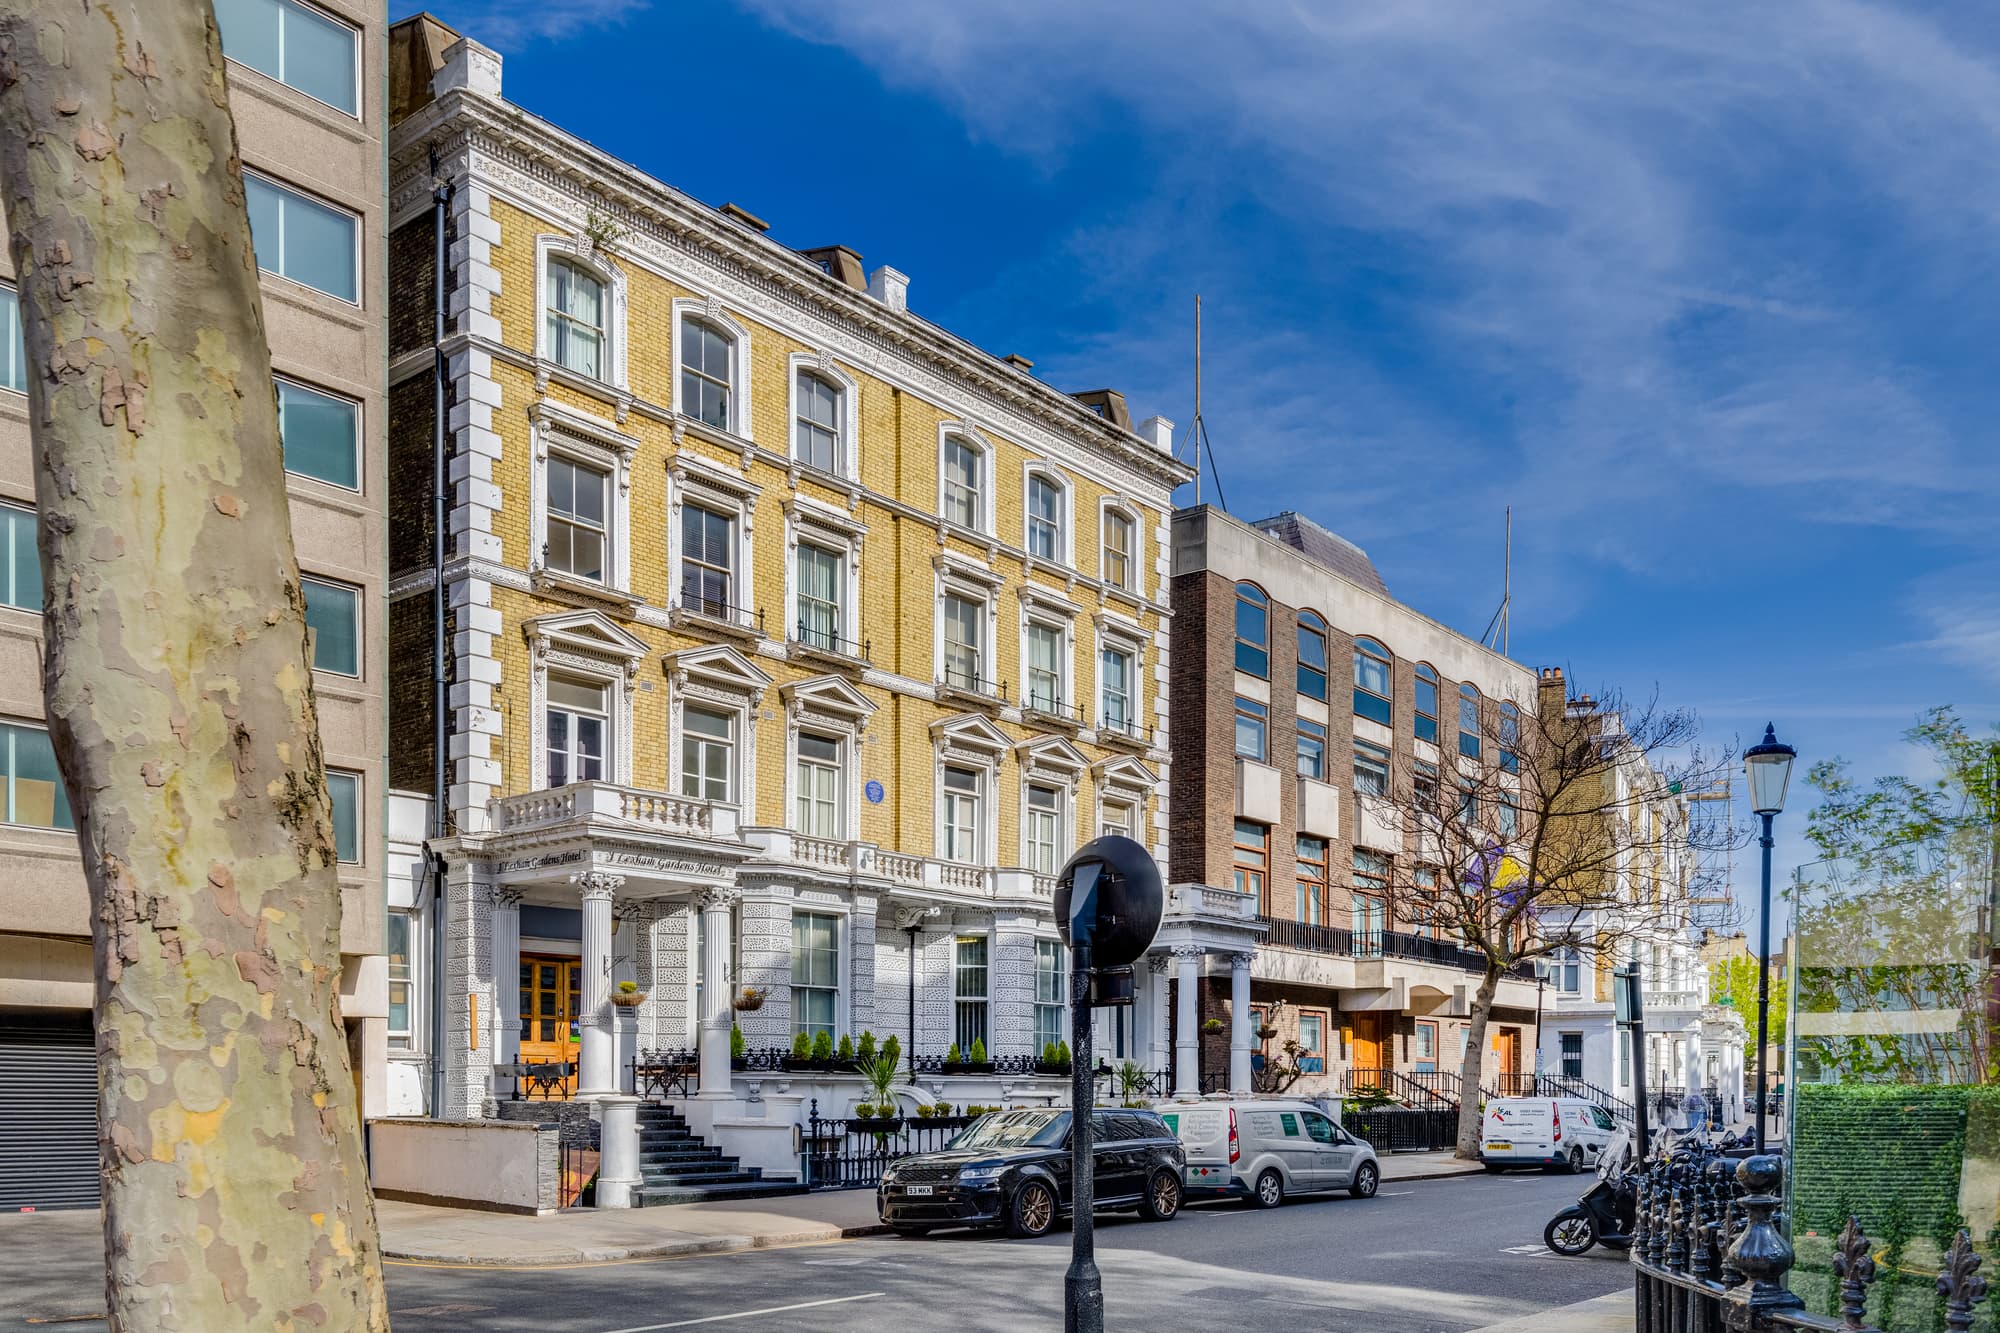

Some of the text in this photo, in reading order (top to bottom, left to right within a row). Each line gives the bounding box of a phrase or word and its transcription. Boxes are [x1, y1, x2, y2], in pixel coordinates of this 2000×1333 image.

[559, 849, 582, 865] Hotel
[616, 852, 655, 866] Lexham
[655, 857, 694, 872] Gardens
[694, 862, 722, 876] Hotel
